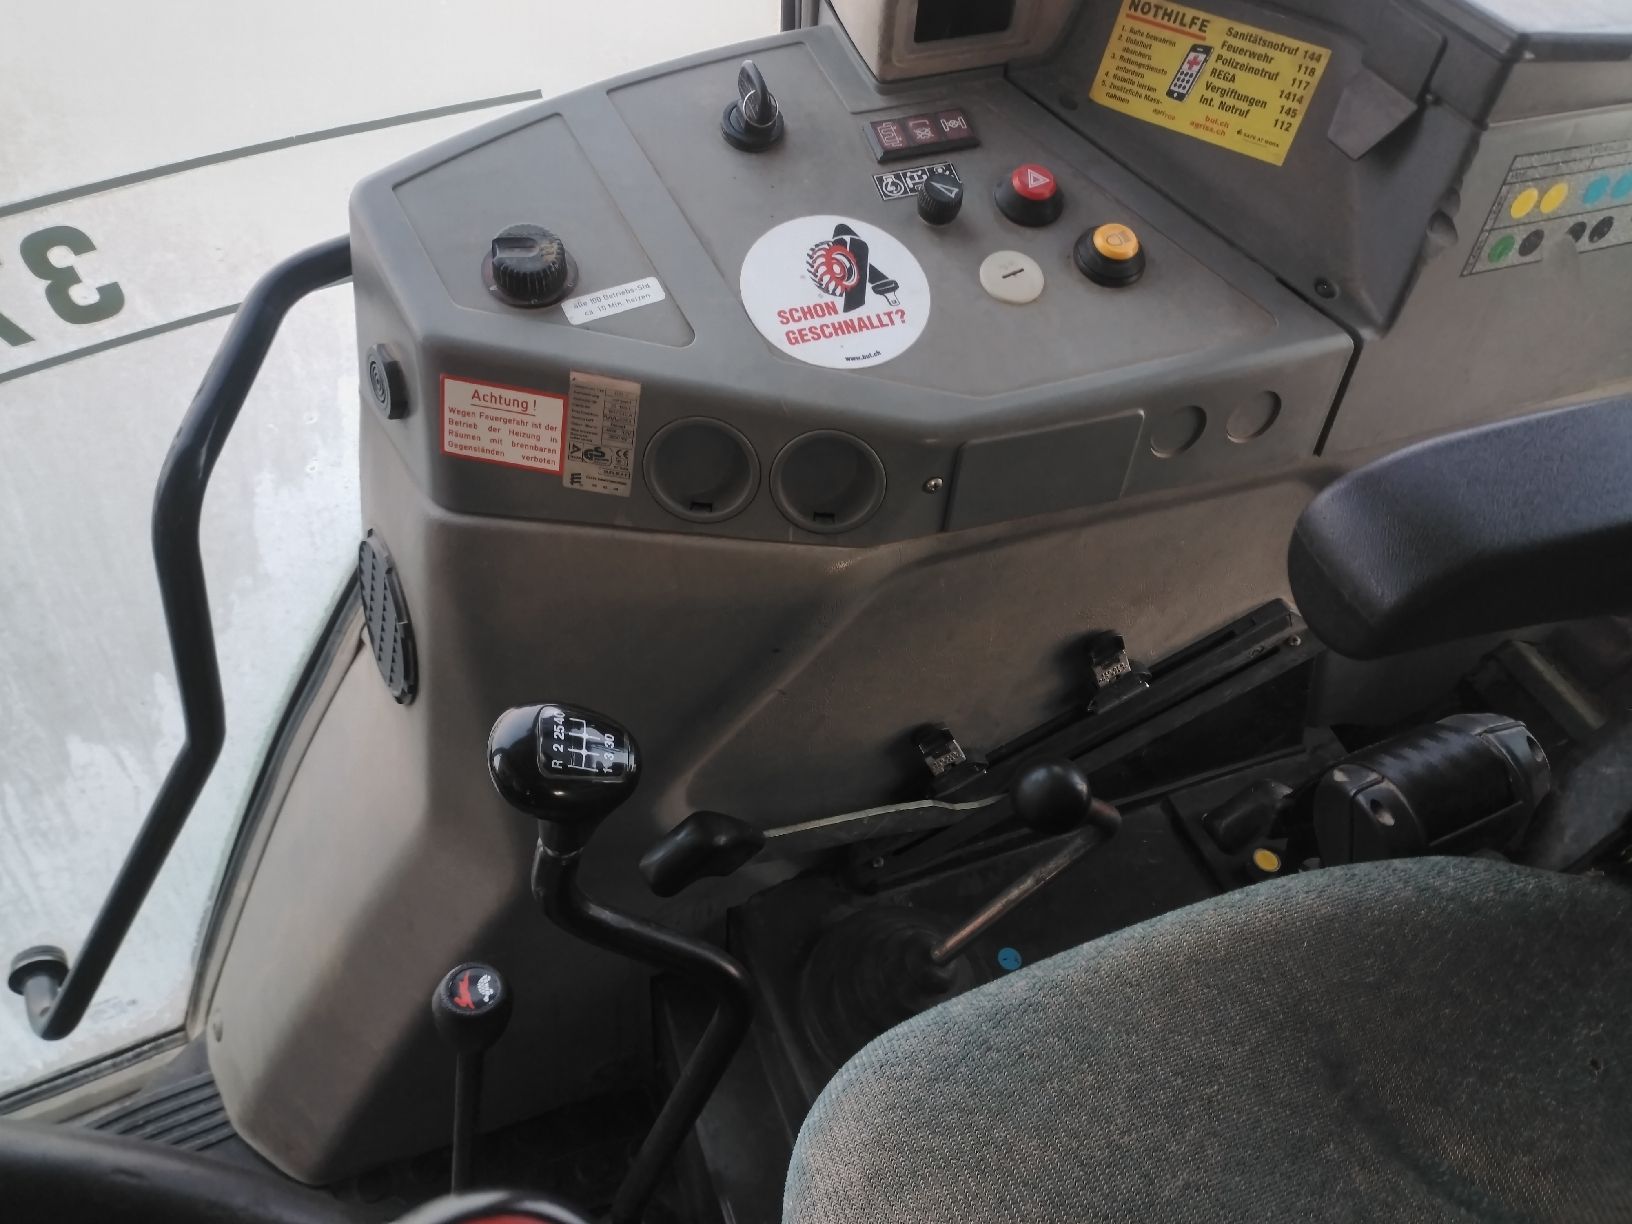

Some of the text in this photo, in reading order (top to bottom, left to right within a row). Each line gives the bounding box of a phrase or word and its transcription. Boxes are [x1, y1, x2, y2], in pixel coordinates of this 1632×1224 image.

[1128, 0, 1210, 34] NOTHILFE
[1226, 27, 1323, 63] Sanitätsnotruf 144
[1221, 40, 1316, 77] Feuerwehr 118
[1215, 54, 1311, 91] Polizeinotruf 117
[1210, 67, 1305, 105] REGA 1414
[1204, 81, 1299, 119] Vergiftungen 145
[1199, 95, 1293, 132] Int. Notruf 112
[777, 301, 839, 326] SCHON
[785, 308, 906, 346] GESCHNALLT?
[845, 350, 882, 362] www.bul.ch
[471, 389, 529, 412] Achtung
[448, 406, 558, 432] Wegen Feuergefahr ist der
[448, 418, 478, 430] Betrieb
[487, 425, 501, 434] der
[509, 429, 541, 442] Heizung
[550, 436, 558, 444] in
[489, 437, 503, 446] mit
[511, 440, 557, 455] brennbaren
[521, 453, 556, 465] verboten
[552, 744, 564, 753] 2
[604, 734, 615, 749] 30
[551, 760, 563, 769] R
[603, 752, 615, 761] 3
